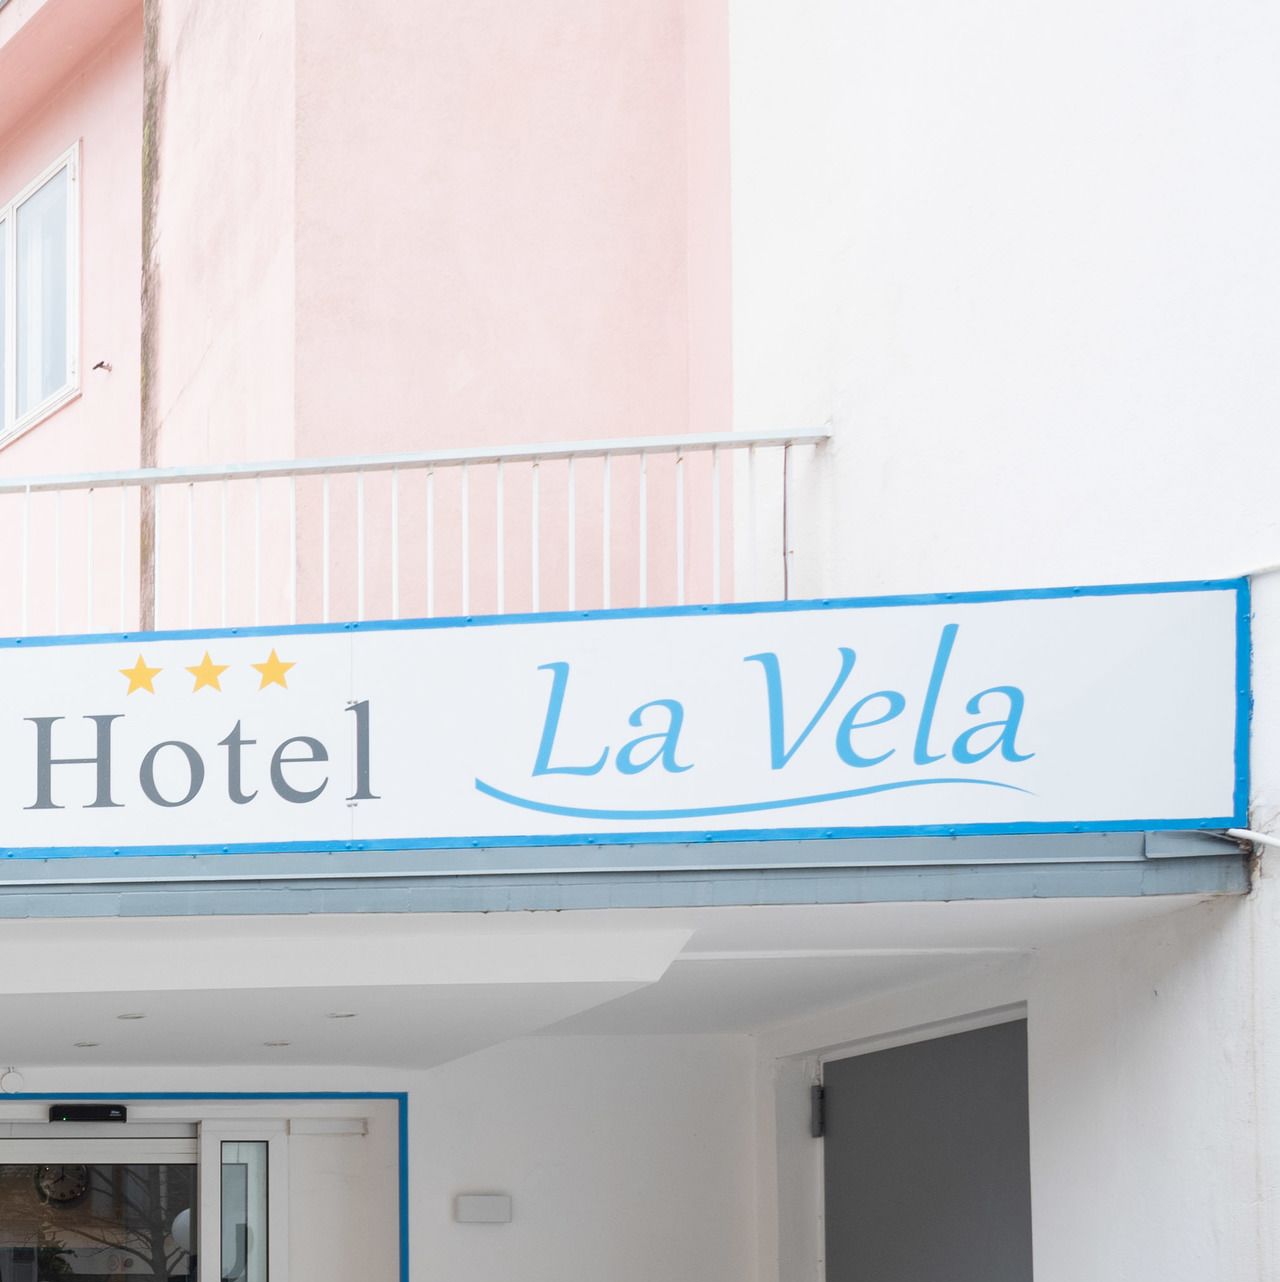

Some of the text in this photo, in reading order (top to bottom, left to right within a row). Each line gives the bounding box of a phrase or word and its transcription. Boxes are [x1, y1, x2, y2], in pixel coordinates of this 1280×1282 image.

[22, 623, 1037, 811] Hotel La Vela
